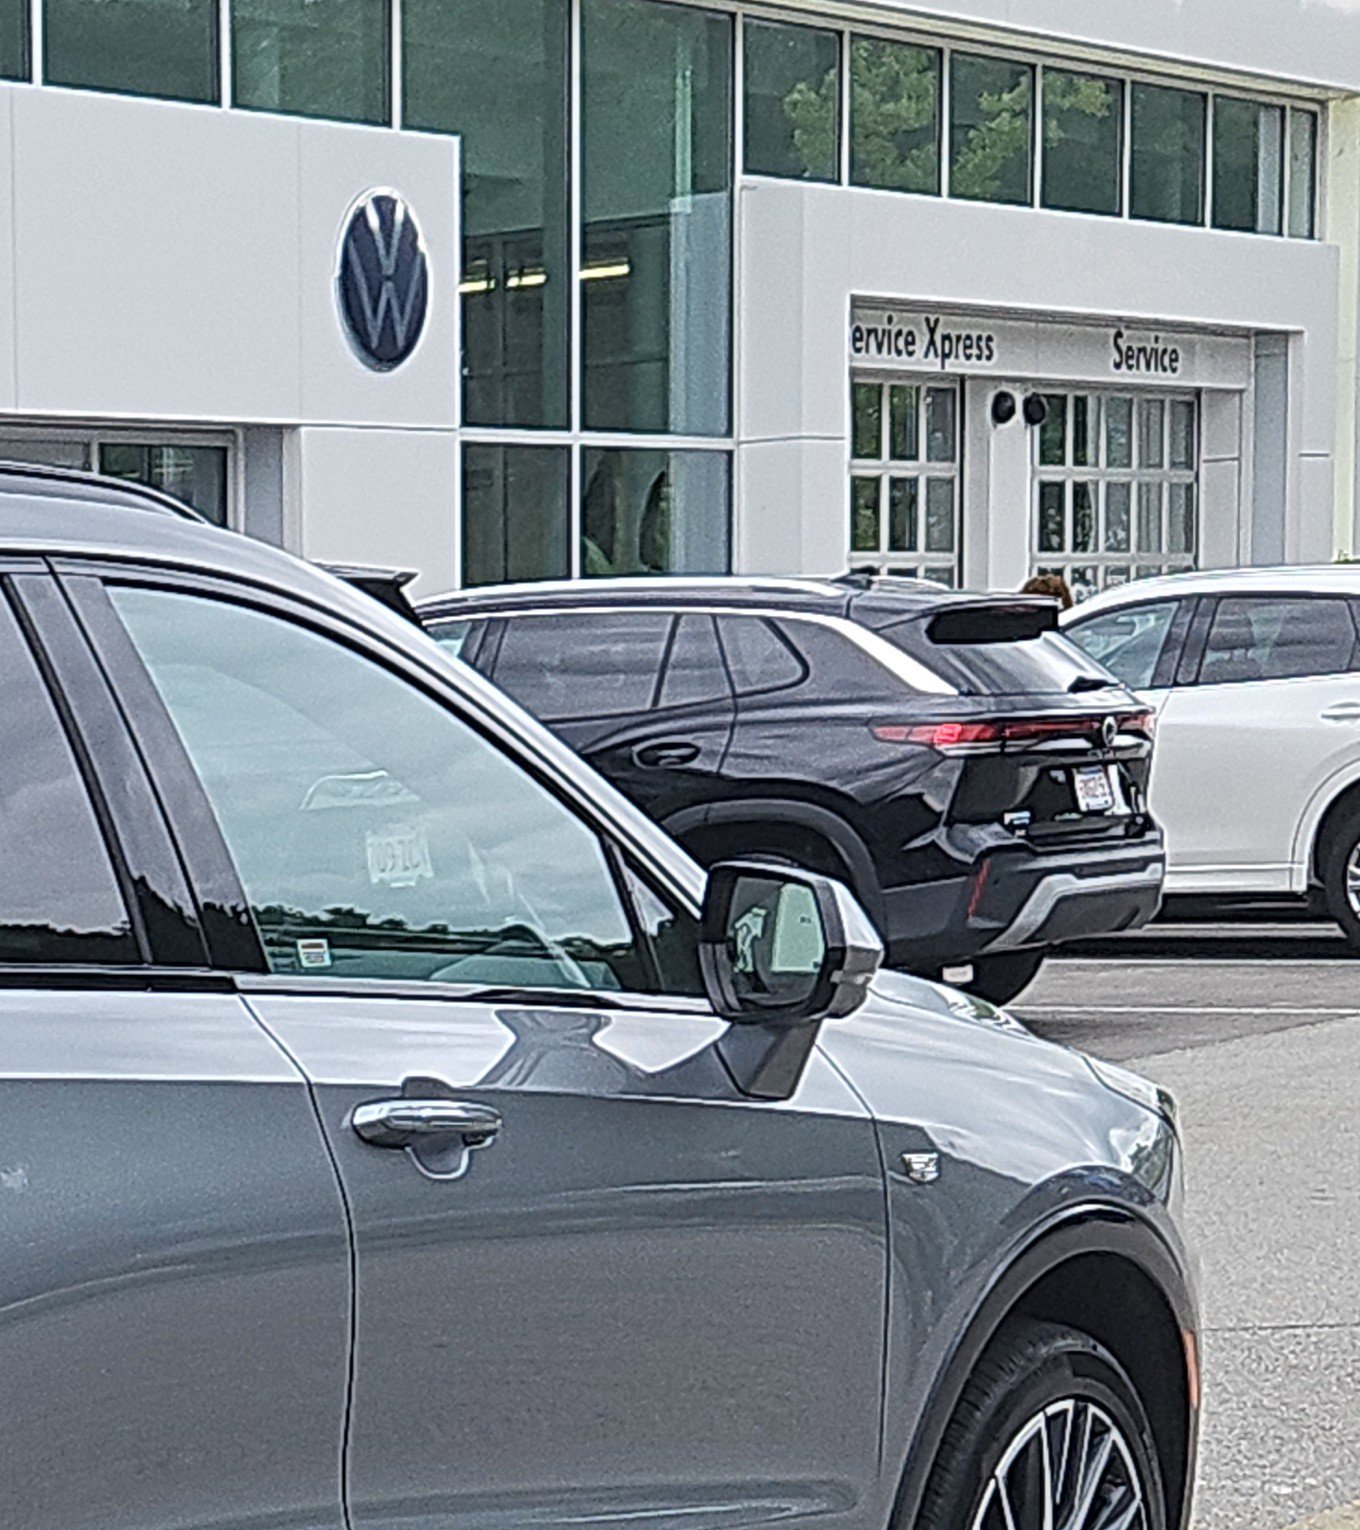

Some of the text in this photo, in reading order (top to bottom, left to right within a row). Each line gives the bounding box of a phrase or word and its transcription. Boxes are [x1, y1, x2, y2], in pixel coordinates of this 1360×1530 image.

[851, 314, 994, 370] ervice Xpress
[1113, 330, 1180, 374] Service
